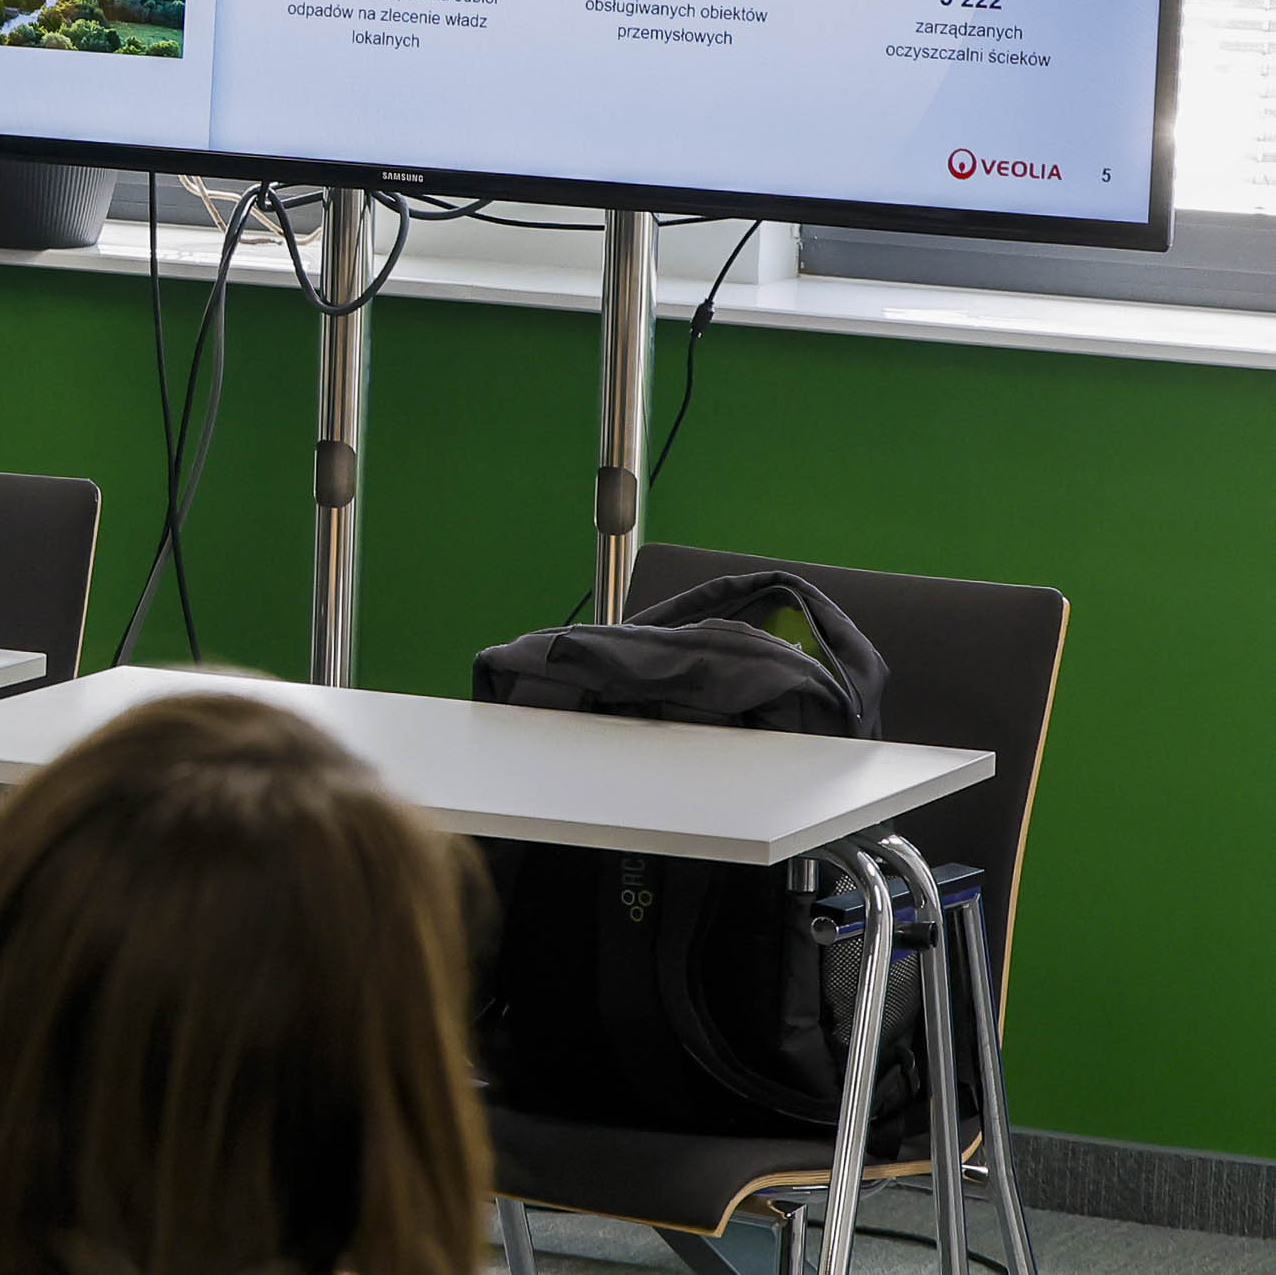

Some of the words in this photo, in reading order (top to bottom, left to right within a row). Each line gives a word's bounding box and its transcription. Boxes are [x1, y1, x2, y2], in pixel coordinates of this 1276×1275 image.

[287, 1, 354, 19] odpadów
[358, 8, 376, 21] na
[380, 7, 441, 25] zlecenie
[444, 12, 488, 29] władz
[700, 4, 768, 23] obiektów
[352, 29, 420, 50] lokalnych
[617, 26, 733, 47] przemysłowych
[915, 21, 1023, 42] zarządzanych
[885, 45, 984, 62] oczyszczalni
[988, 48, 1051, 67] ścieków
[382, 171, 424, 183] SAMSUNG
[980, 158, 1063, 181] VEOLIA
[1101, 168, 1111, 183] 5
